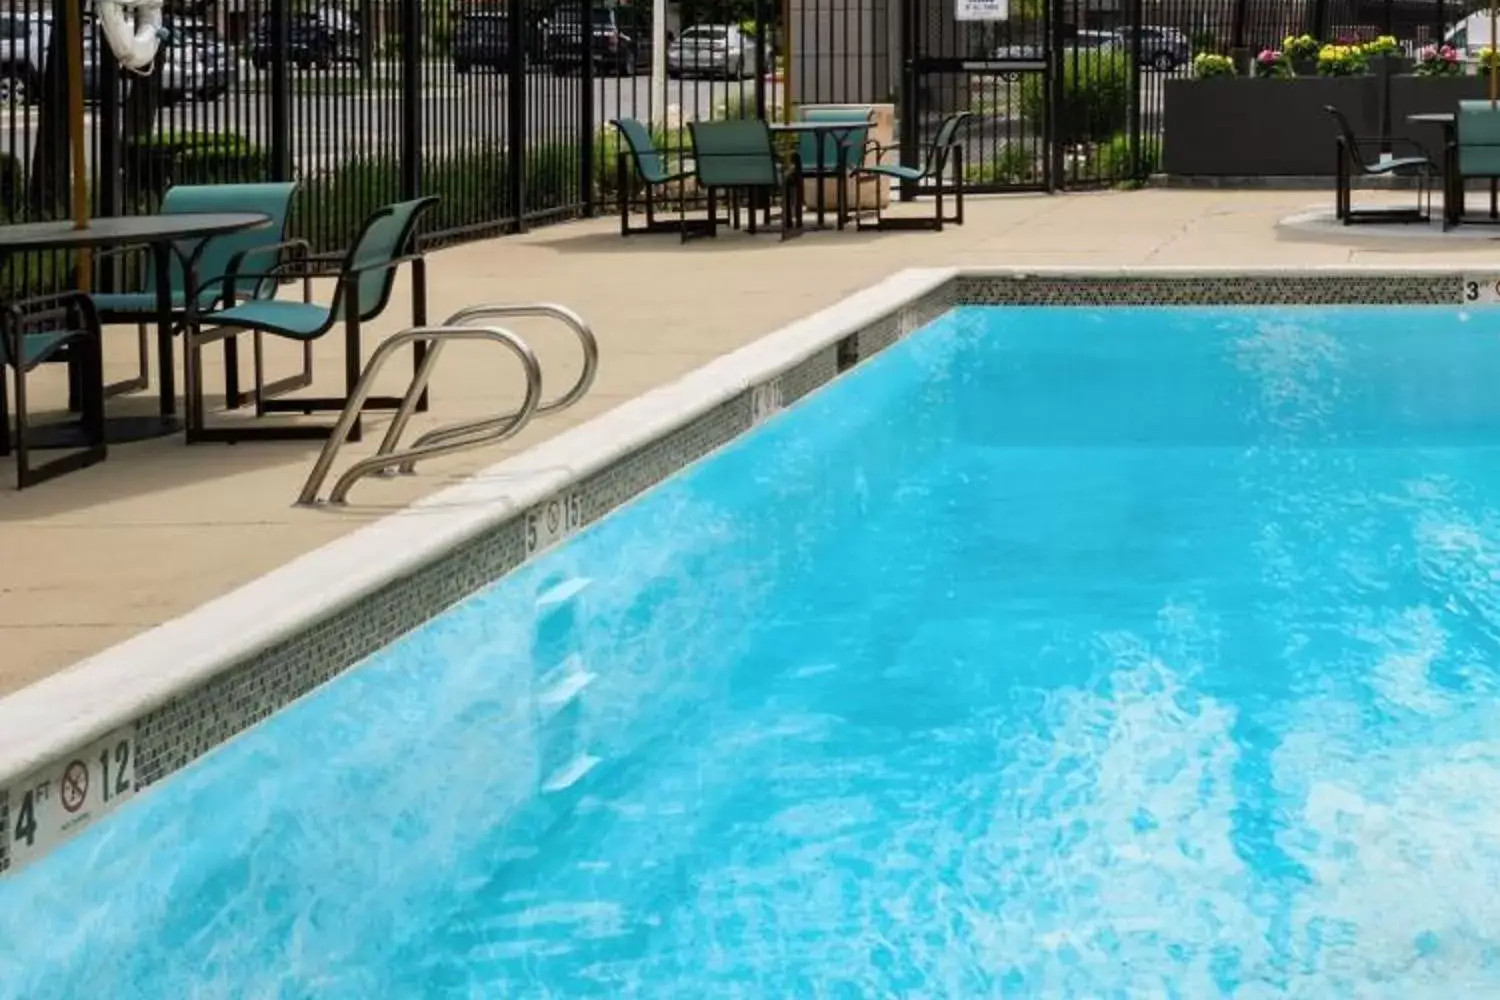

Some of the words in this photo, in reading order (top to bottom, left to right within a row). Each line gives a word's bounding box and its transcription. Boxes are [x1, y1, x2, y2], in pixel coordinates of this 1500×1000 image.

[1466, 281, 1479, 301] 3
[527, 514, 538, 553] 5
[14, 788, 38, 847] 4
